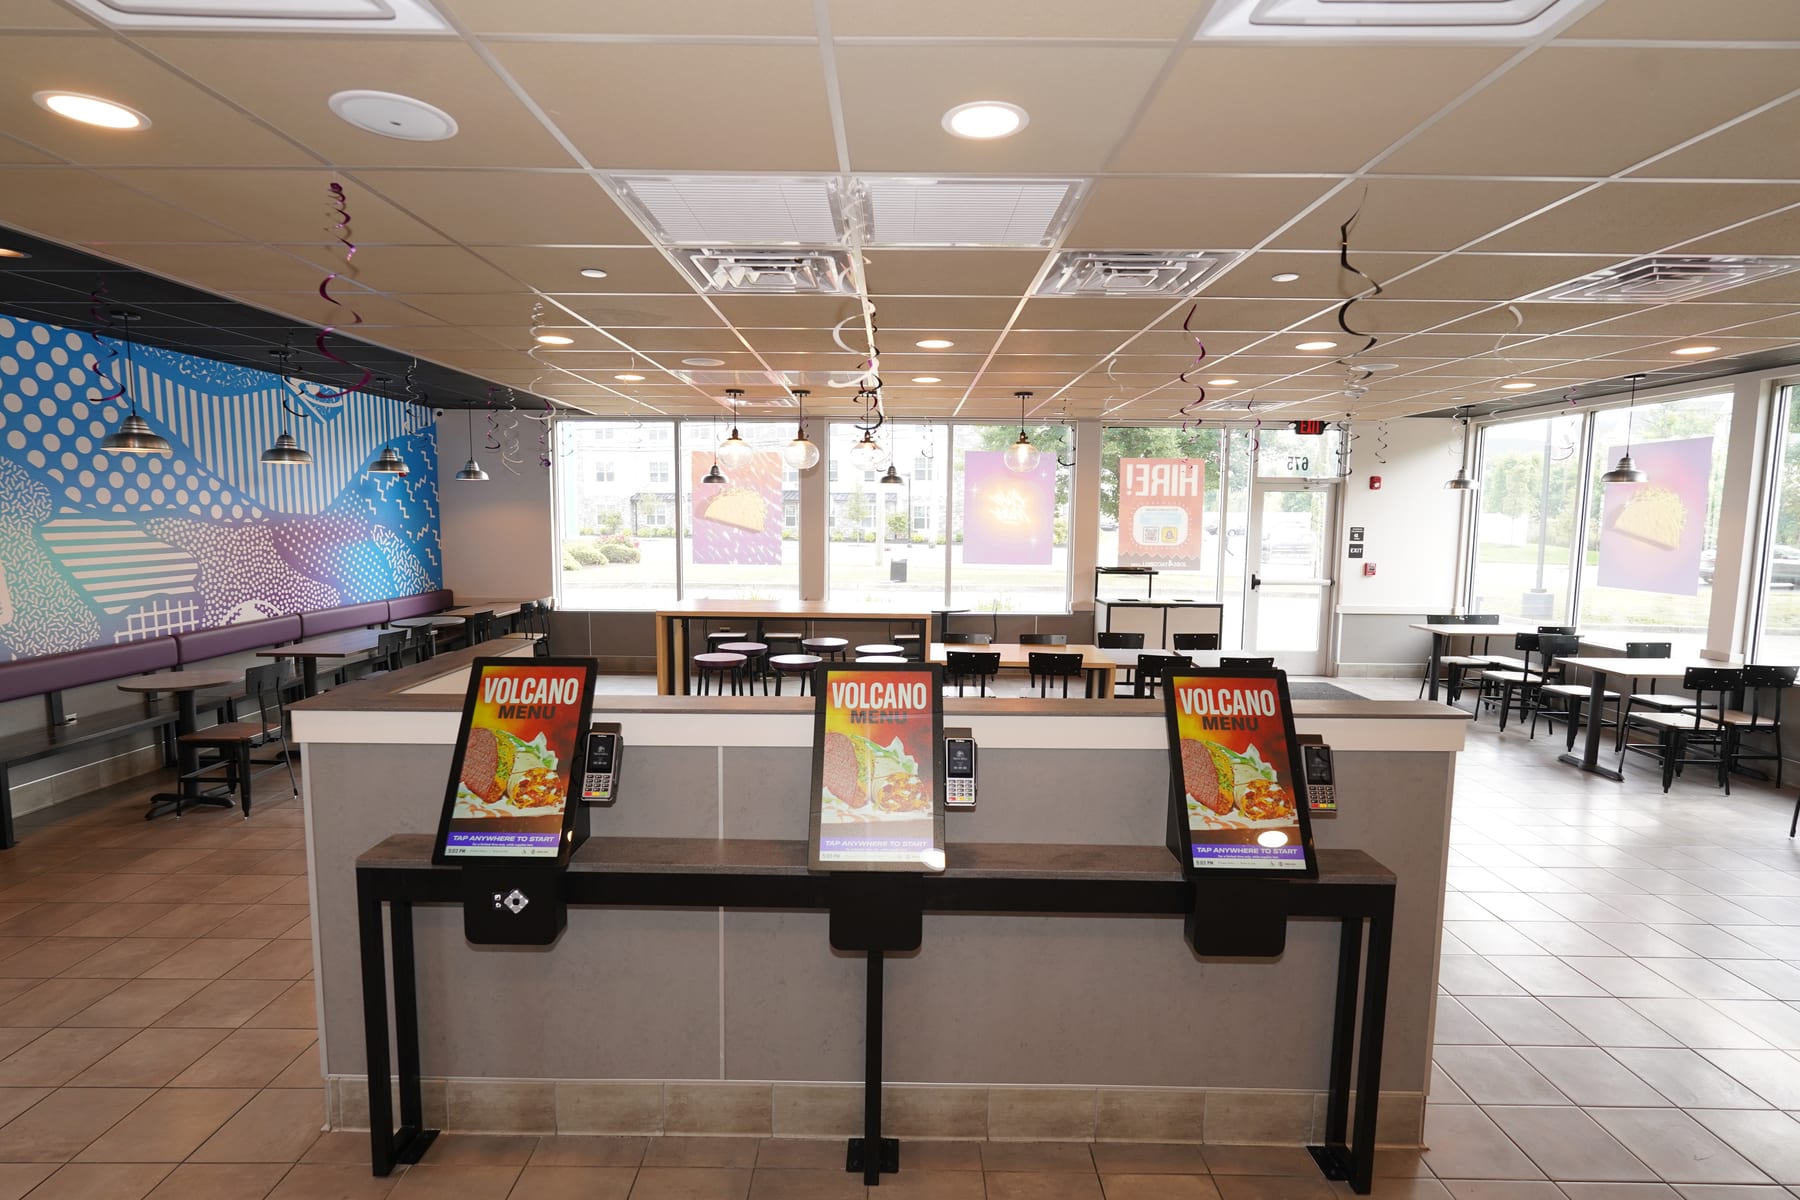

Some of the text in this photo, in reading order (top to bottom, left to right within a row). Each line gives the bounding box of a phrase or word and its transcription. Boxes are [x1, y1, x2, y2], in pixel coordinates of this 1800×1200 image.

[1299, 420, 1320, 434] EXIT
[484, 677, 579, 705] VOLCANO
[831, 681, 927, 710] VOLCANO
[1179, 688, 1276, 717] VOLCANO
[497, 705, 557, 720] MENU
[850, 709, 908, 724] MENU
[1202, 716, 1259, 731] MENU
